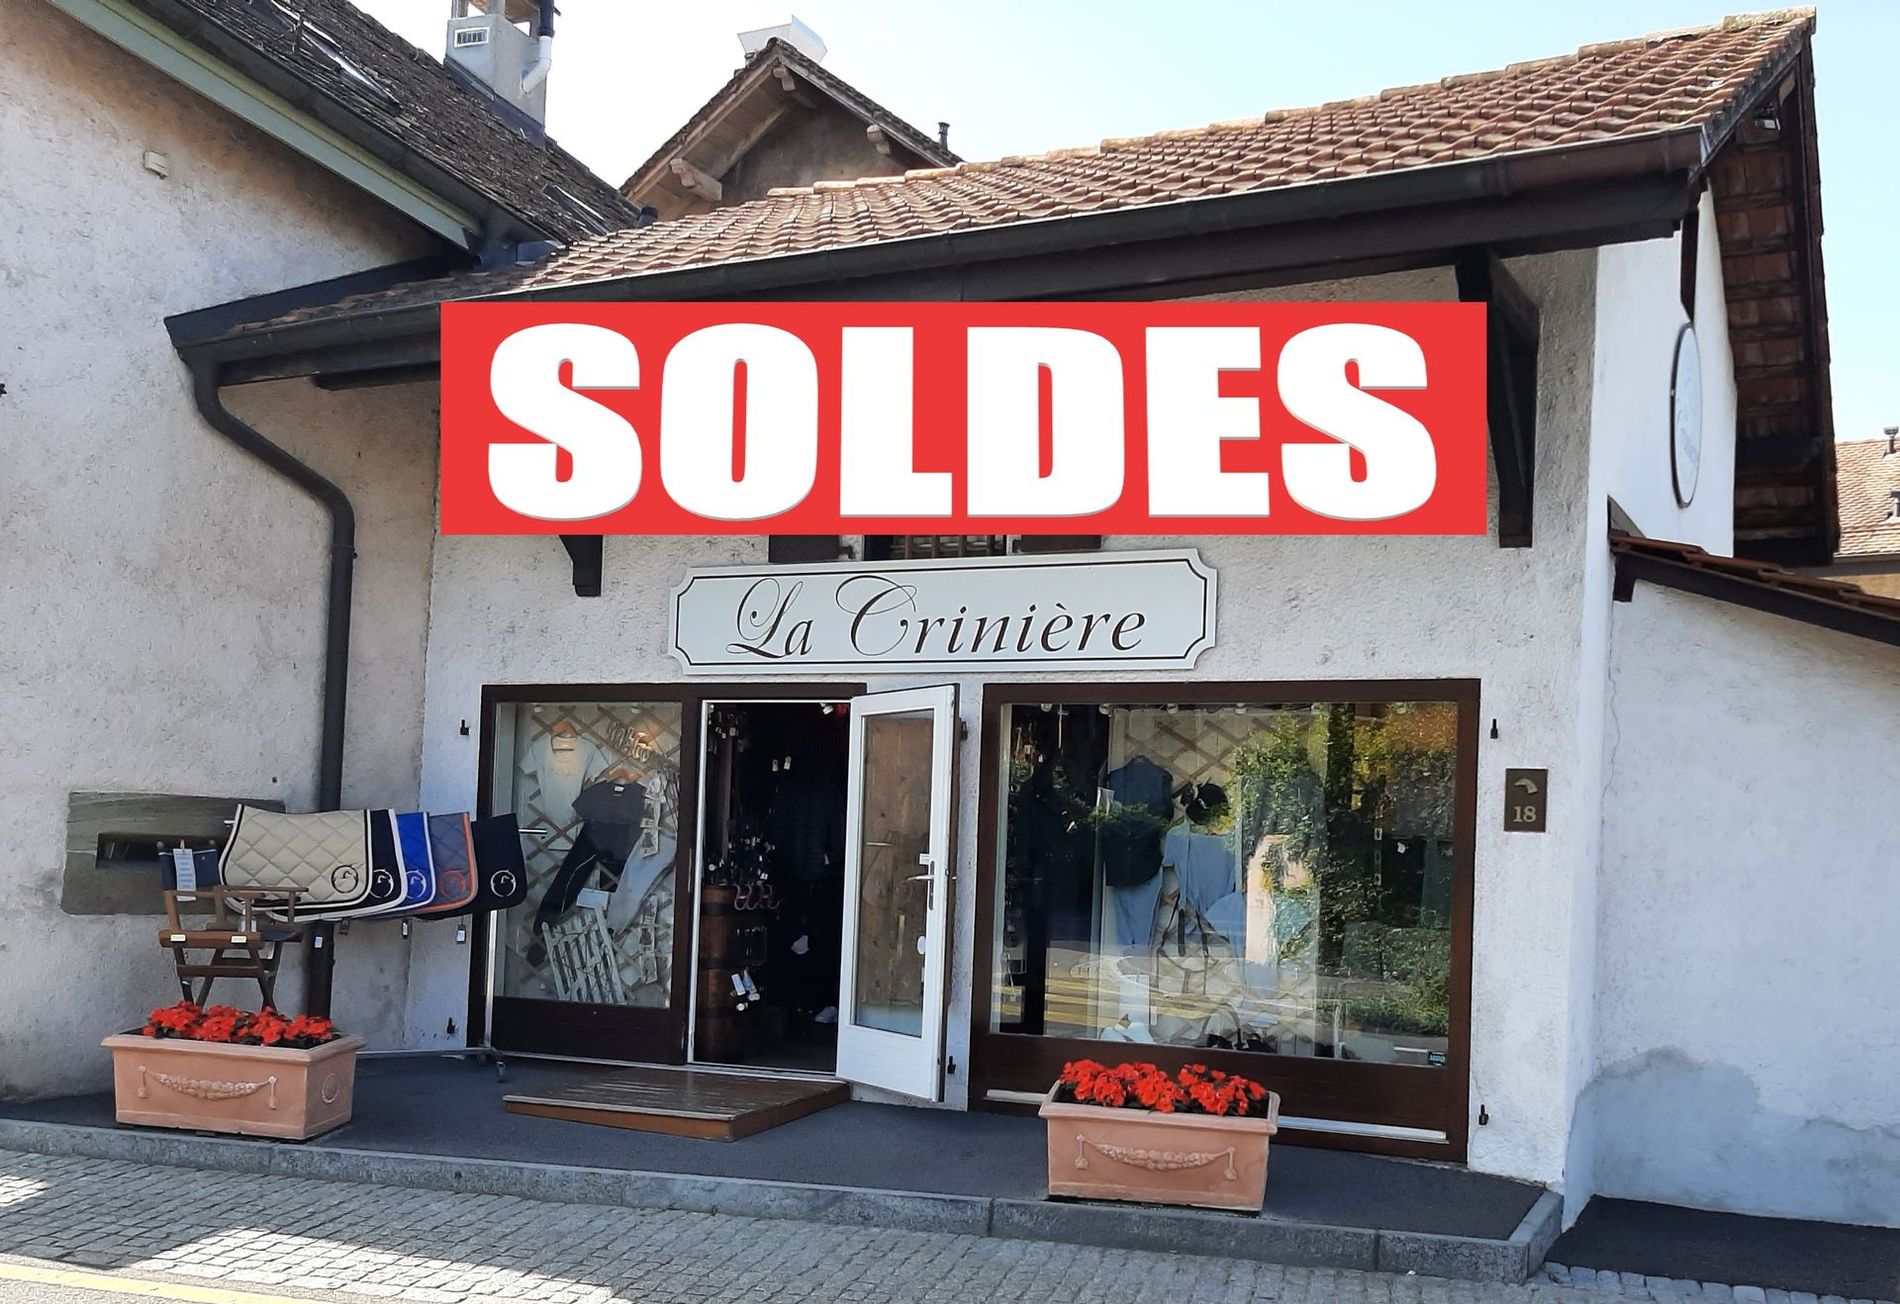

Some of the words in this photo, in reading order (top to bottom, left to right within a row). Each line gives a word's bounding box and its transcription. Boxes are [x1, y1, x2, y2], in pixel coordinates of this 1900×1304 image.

[726, 577, 814, 659] La
[835, 575, 1146, 657] Crinière
[1512, 805, 1537, 823] 18
